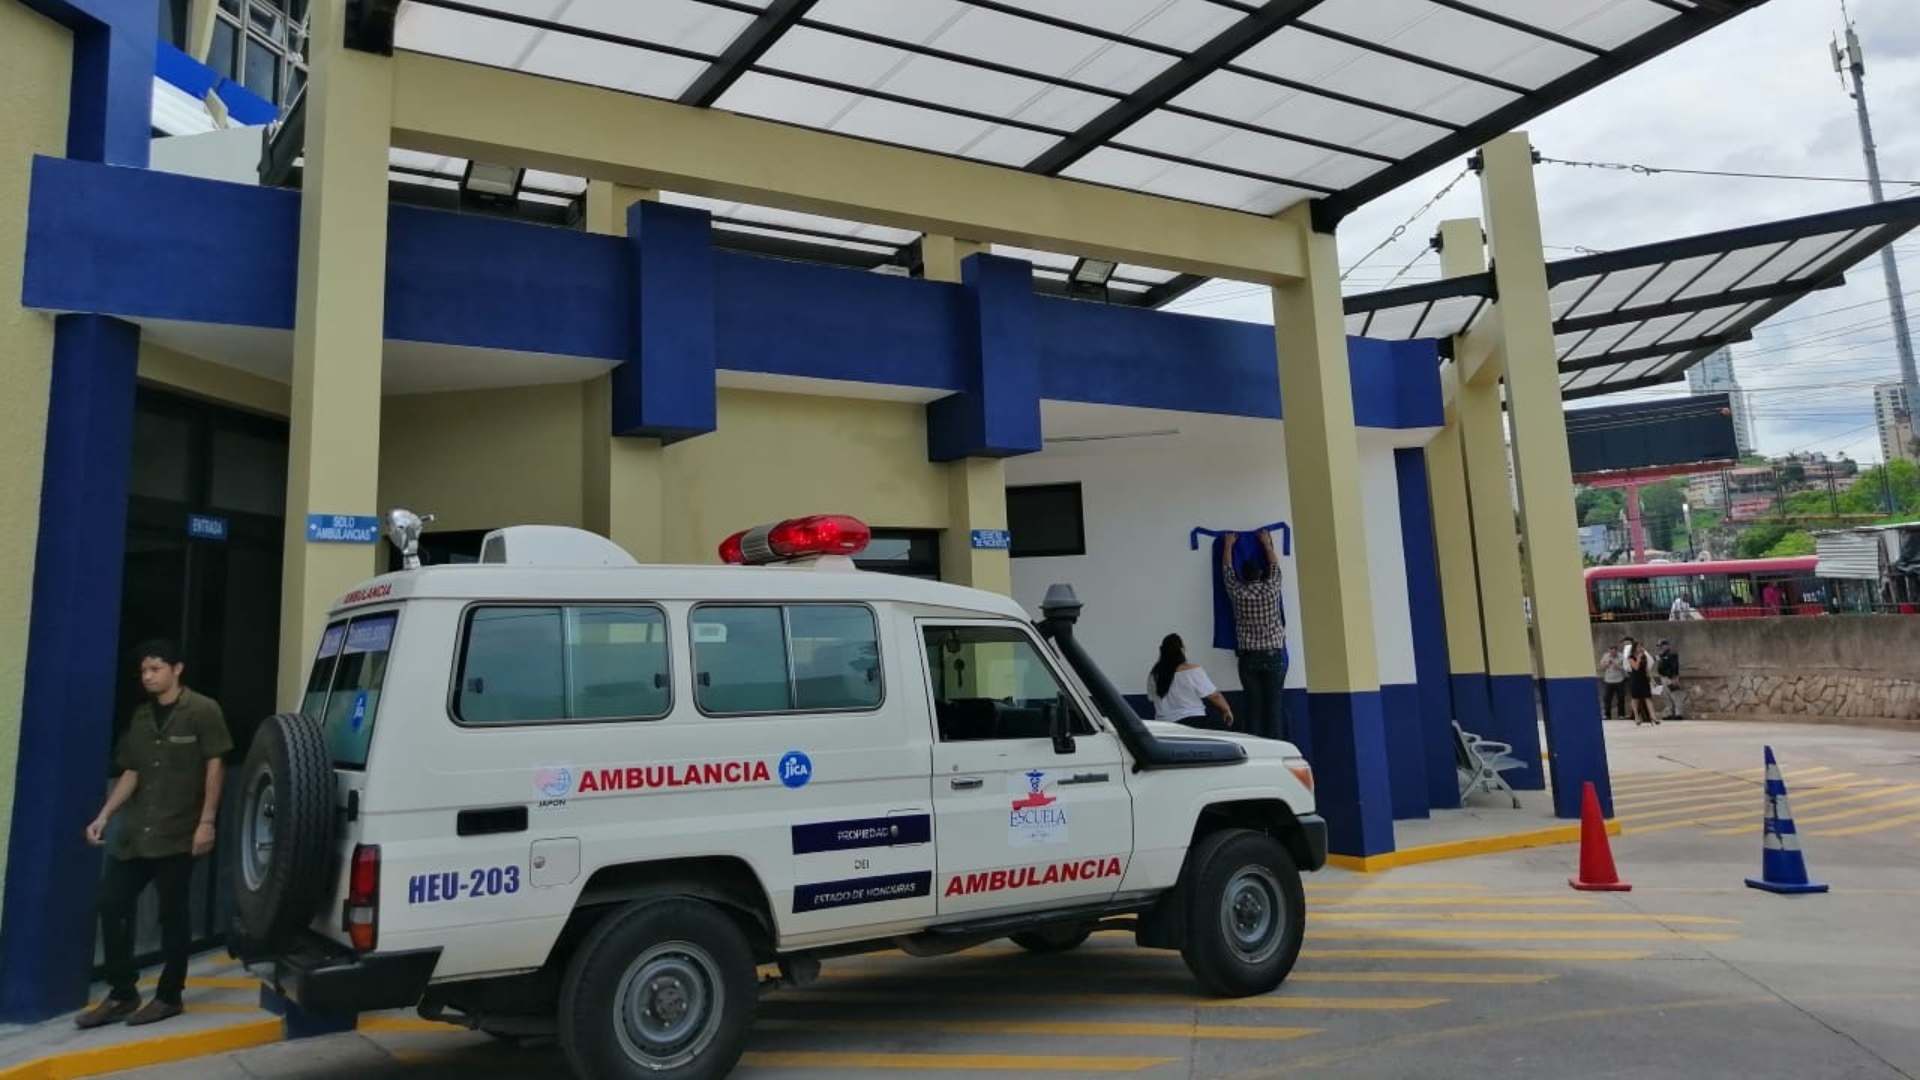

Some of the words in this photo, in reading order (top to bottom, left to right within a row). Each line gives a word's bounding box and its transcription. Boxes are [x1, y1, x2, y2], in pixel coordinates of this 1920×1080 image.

[192, 518, 223, 534] ENTRADA
[333, 516, 355, 528] SOLO
[316, 528, 371, 541] AMBULANCIAS
[578, 761, 770, 793] AMBULANCIA
[1010, 809, 1066, 827] ESCUELA
[837, 827, 889, 841] PROPIEDAD
[408, 865, 520, 904] HEU-203
[945, 857, 1122, 897] AMBULANCIA
[814, 891, 850, 905] ESTADO
[851, 889, 865, 899] DE
[866, 883, 916, 897] HONDURAS
